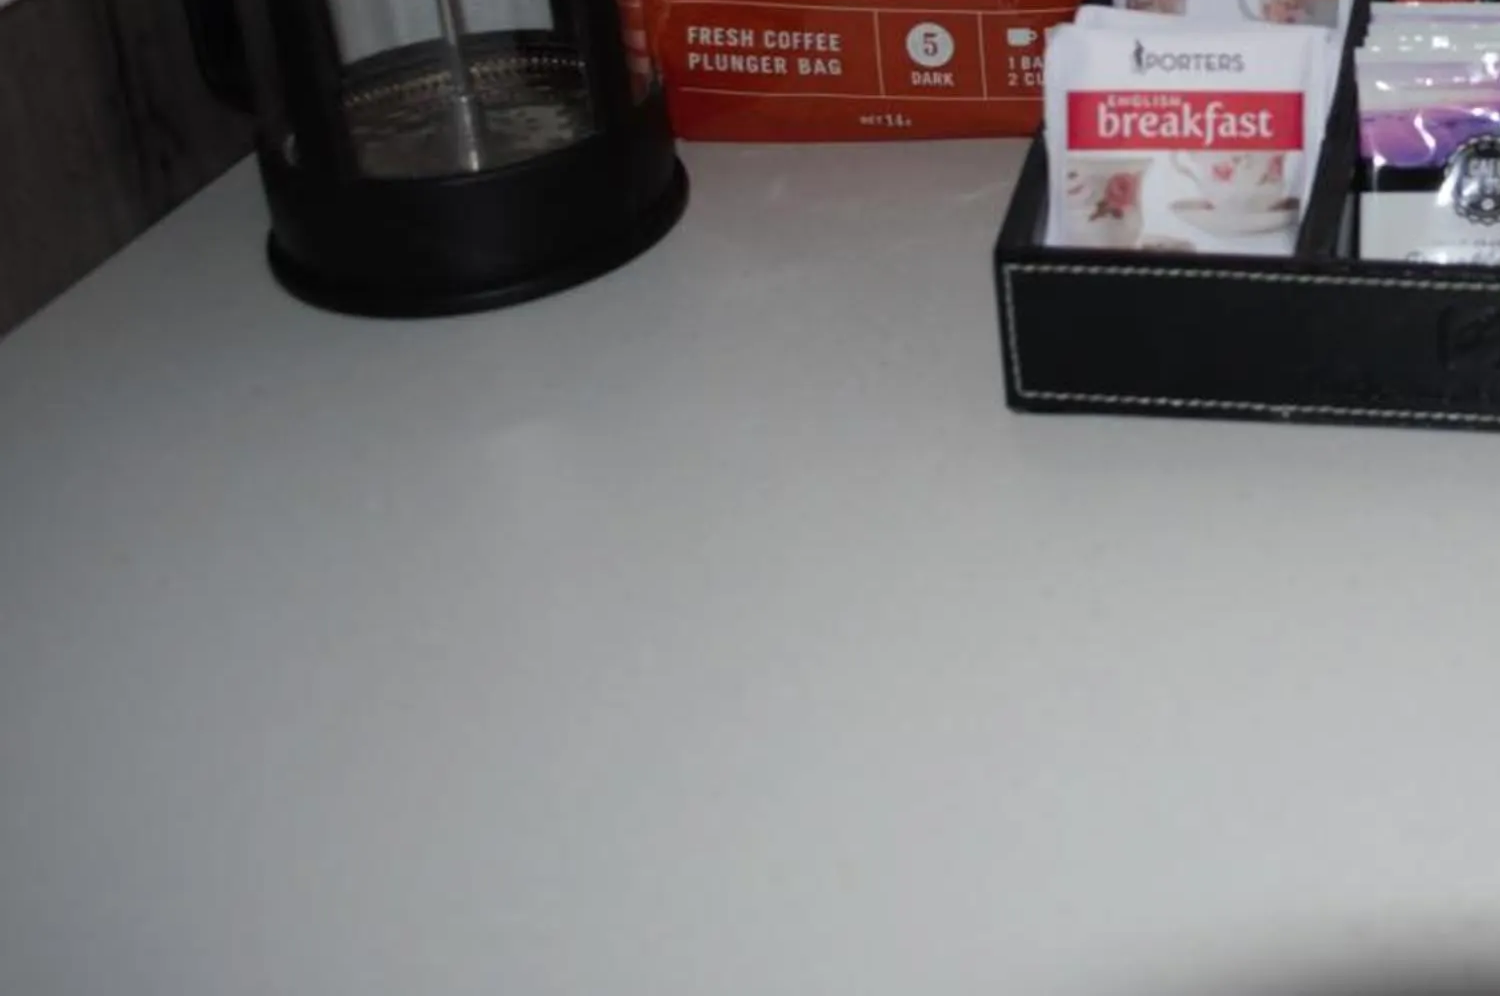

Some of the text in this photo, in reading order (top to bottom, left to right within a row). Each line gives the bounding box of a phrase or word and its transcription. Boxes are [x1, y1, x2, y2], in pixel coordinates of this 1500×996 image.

[687, 26, 842, 52] FRESH COFFEE
[920, 32, 939, 57] 5
[688, 52, 843, 76] PLUNGER BAG
[1008, 55, 1043, 72] 1 BA
[1145, 52, 1246, 74] PORTERS
[911, 70, 955, 87] DARK
[1008, 71, 1018, 87] 2
[1097, 101, 1275, 147] breakfast
